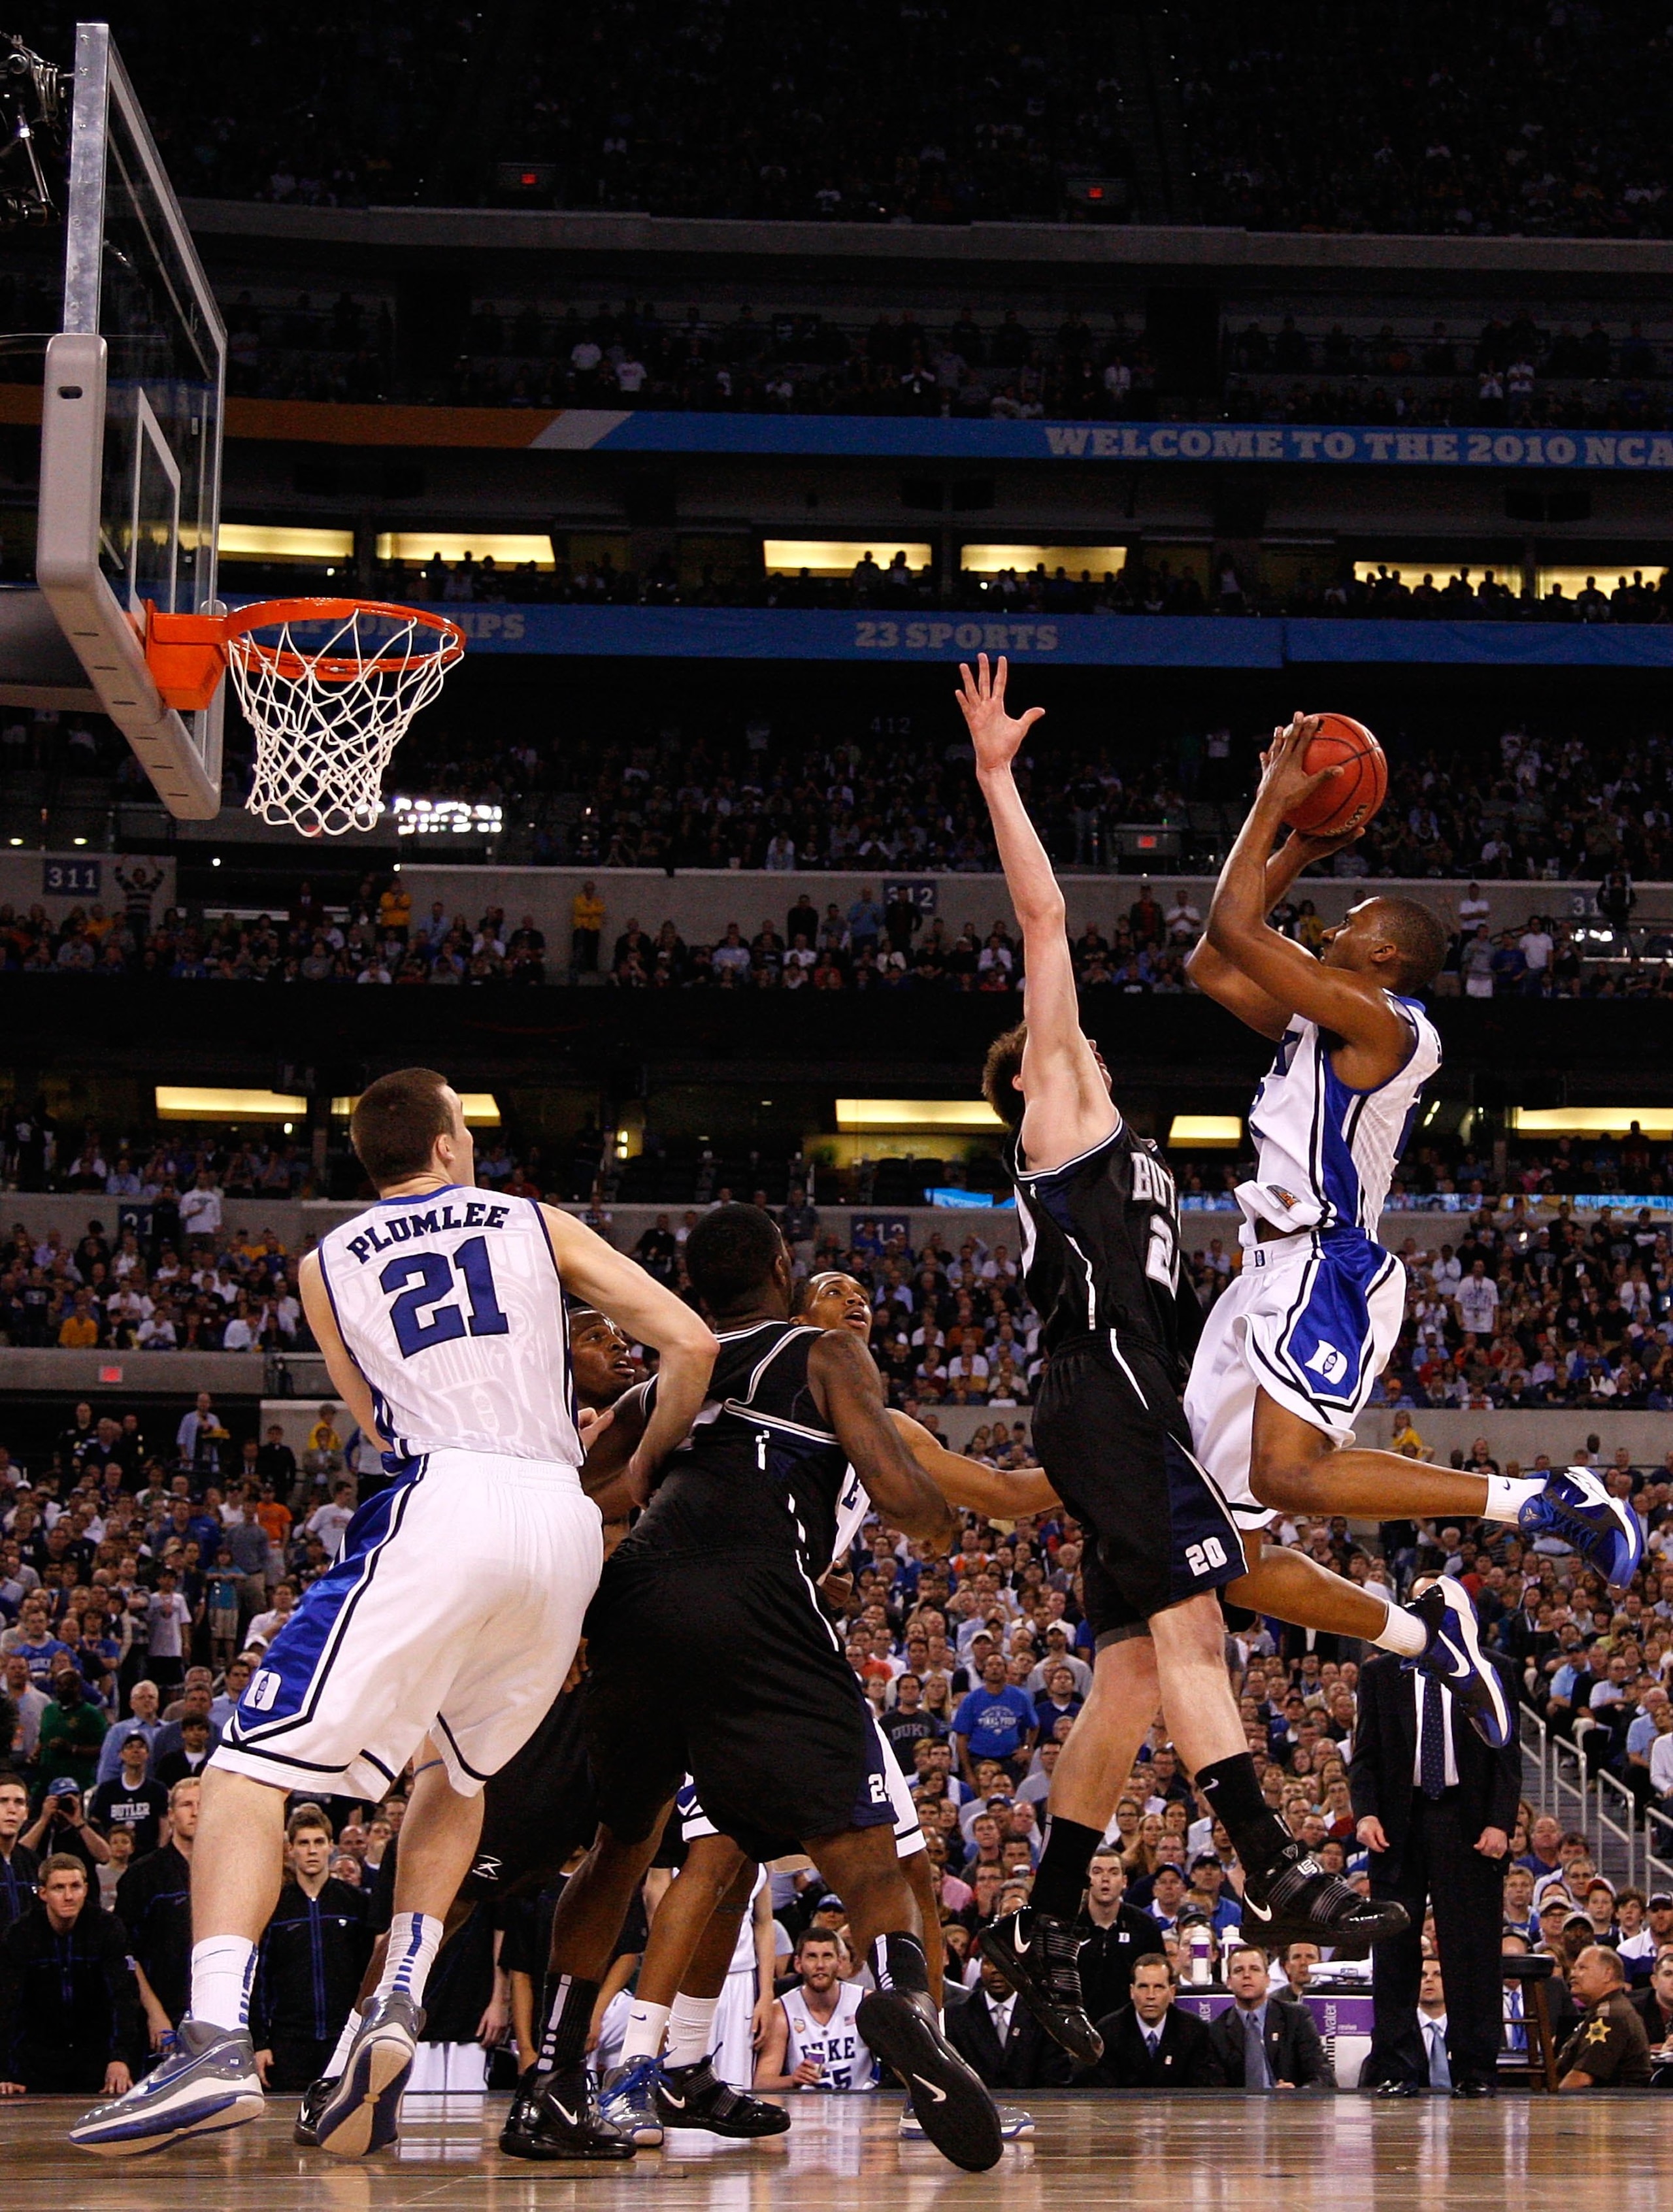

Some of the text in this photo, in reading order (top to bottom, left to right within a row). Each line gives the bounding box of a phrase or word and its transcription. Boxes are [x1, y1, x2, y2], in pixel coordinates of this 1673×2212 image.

[1046, 427, 1283, 458] WELCOME
[1293, 431, 1356, 459] TO
[1363, 433, 1459, 461] THE
[1466, 435, 1577, 464] 2010
[855, 621, 1059, 652] 23 SPORTS
[48, 867, 97, 889] 311
[1573, 896, 1601, 917] 31
[124, 1212, 154, 1235] 21
[346, 1202, 510, 1265] PLUMLEE
[1146, 1213, 1181, 1302] 2
[379, 1235, 509, 1360] 21
[1185, 1536, 1229, 1577] 20
[868, 1773, 889, 1804] 2
[110, 1802, 150, 1819] BUTLER
[801, 2037, 855, 2062] KE
[1322, 2002, 1336, 2066] minwater
